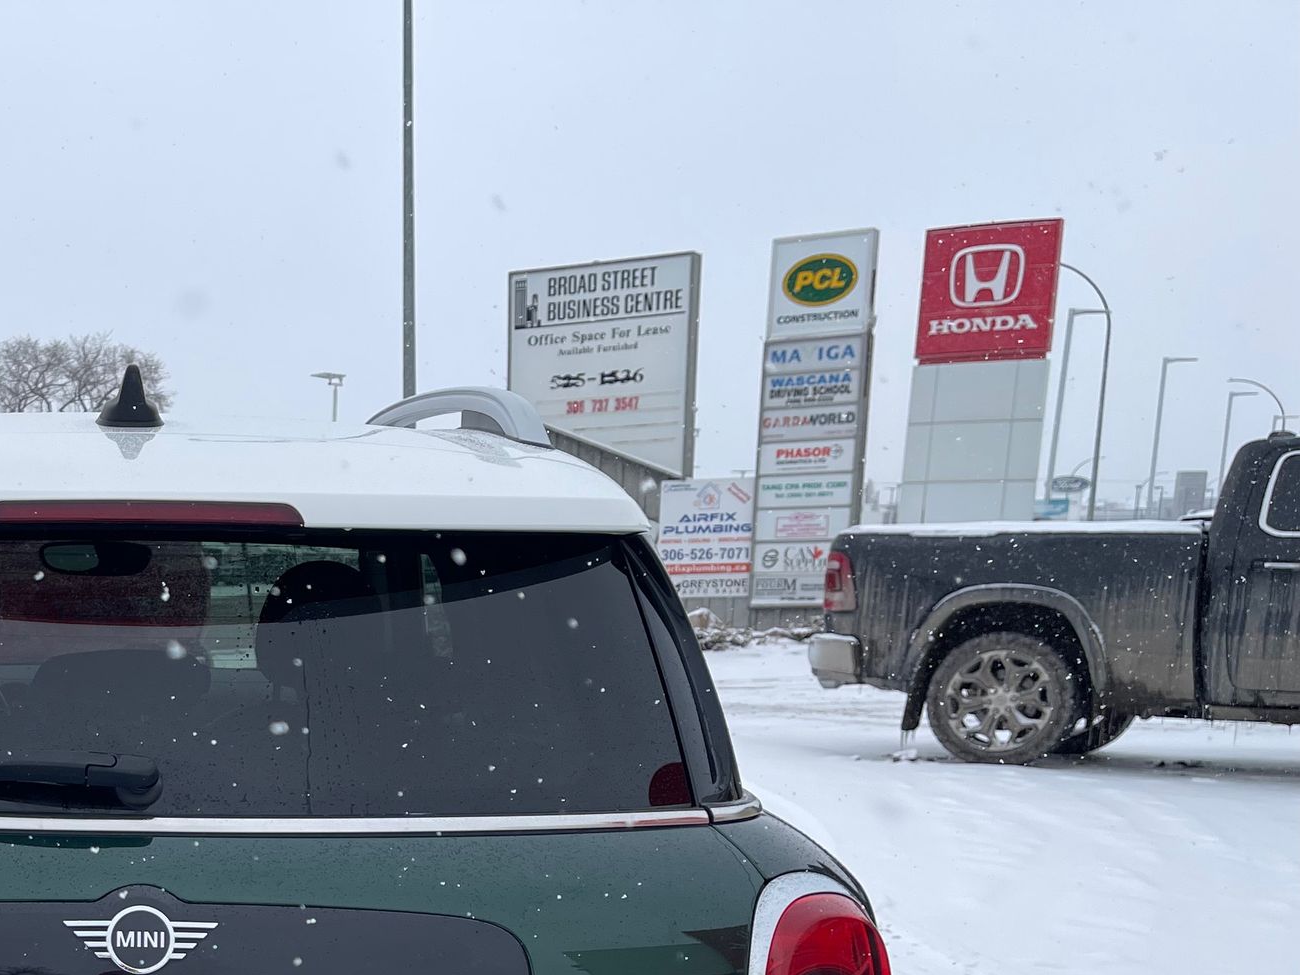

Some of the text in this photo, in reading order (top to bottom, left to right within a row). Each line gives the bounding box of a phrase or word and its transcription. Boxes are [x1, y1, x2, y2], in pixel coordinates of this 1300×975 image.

[548, 266, 658, 297] BROAD STREET
[794, 267, 845, 293] PCL
[547, 289, 683, 321] BUSINESS CENTRE
[777, 309, 860, 325] CONSTRUCTION
[927, 313, 1038, 336] HONDA
[527, 325, 672, 346] Office Space For Lease
[771, 372, 852, 388] WASCANA
[812, 384, 852, 395] SCHOOL
[592, 398, 609, 413] 737
[614, 396, 640, 411] 3547
[776, 446, 831, 459] PHASOR
[679, 512, 737, 523] AIRFIX
[663, 523, 752, 534] PLUMBING
[661, 547, 749, 561] 306-526-7071
[682, 579, 748, 589] GREYSTONE
[116, 931, 165, 948] MINI
